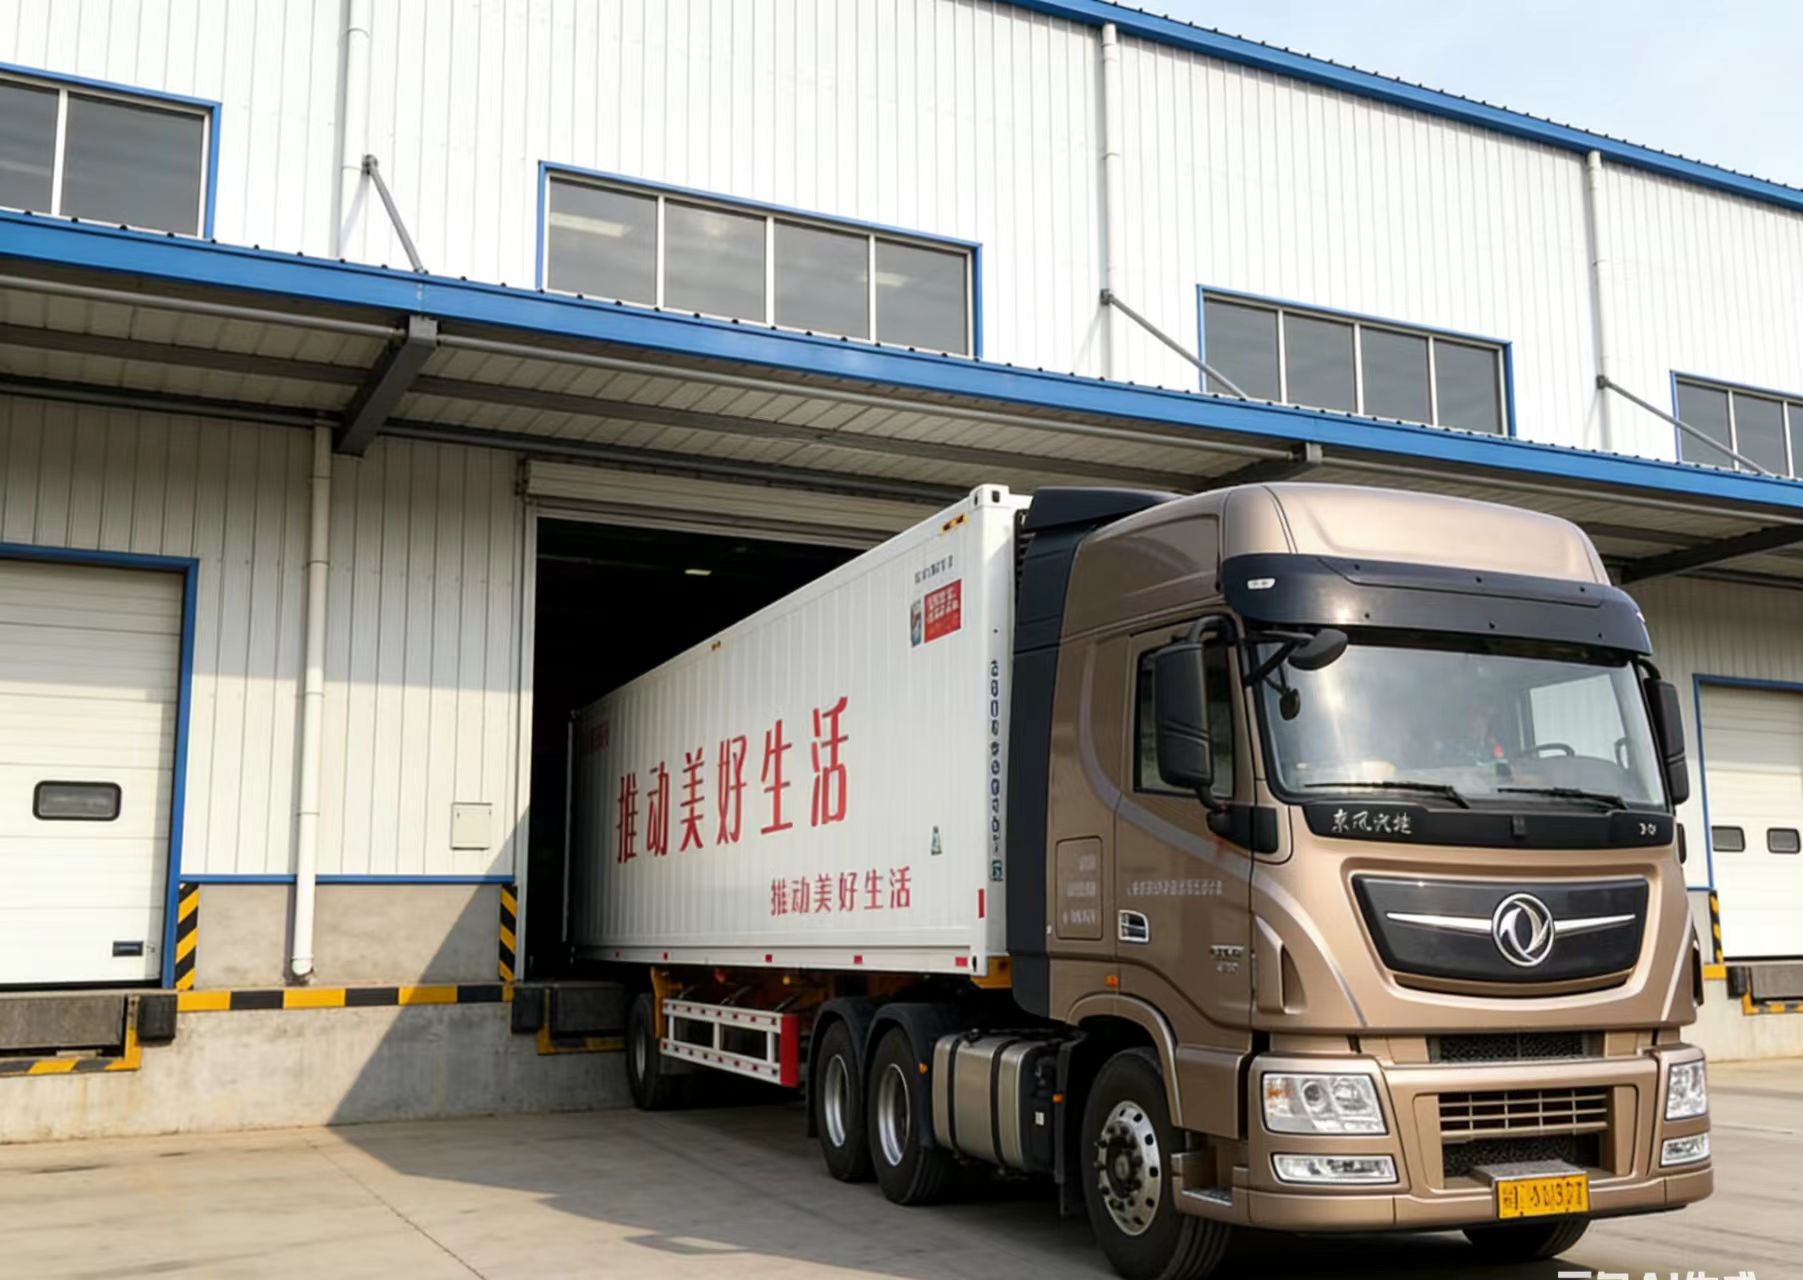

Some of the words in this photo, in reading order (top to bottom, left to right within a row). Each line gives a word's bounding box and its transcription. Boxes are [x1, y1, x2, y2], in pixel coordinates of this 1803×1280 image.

[617, 696, 849, 864] 推动美好生活
[770, 866, 912, 917] 推动美好生活
